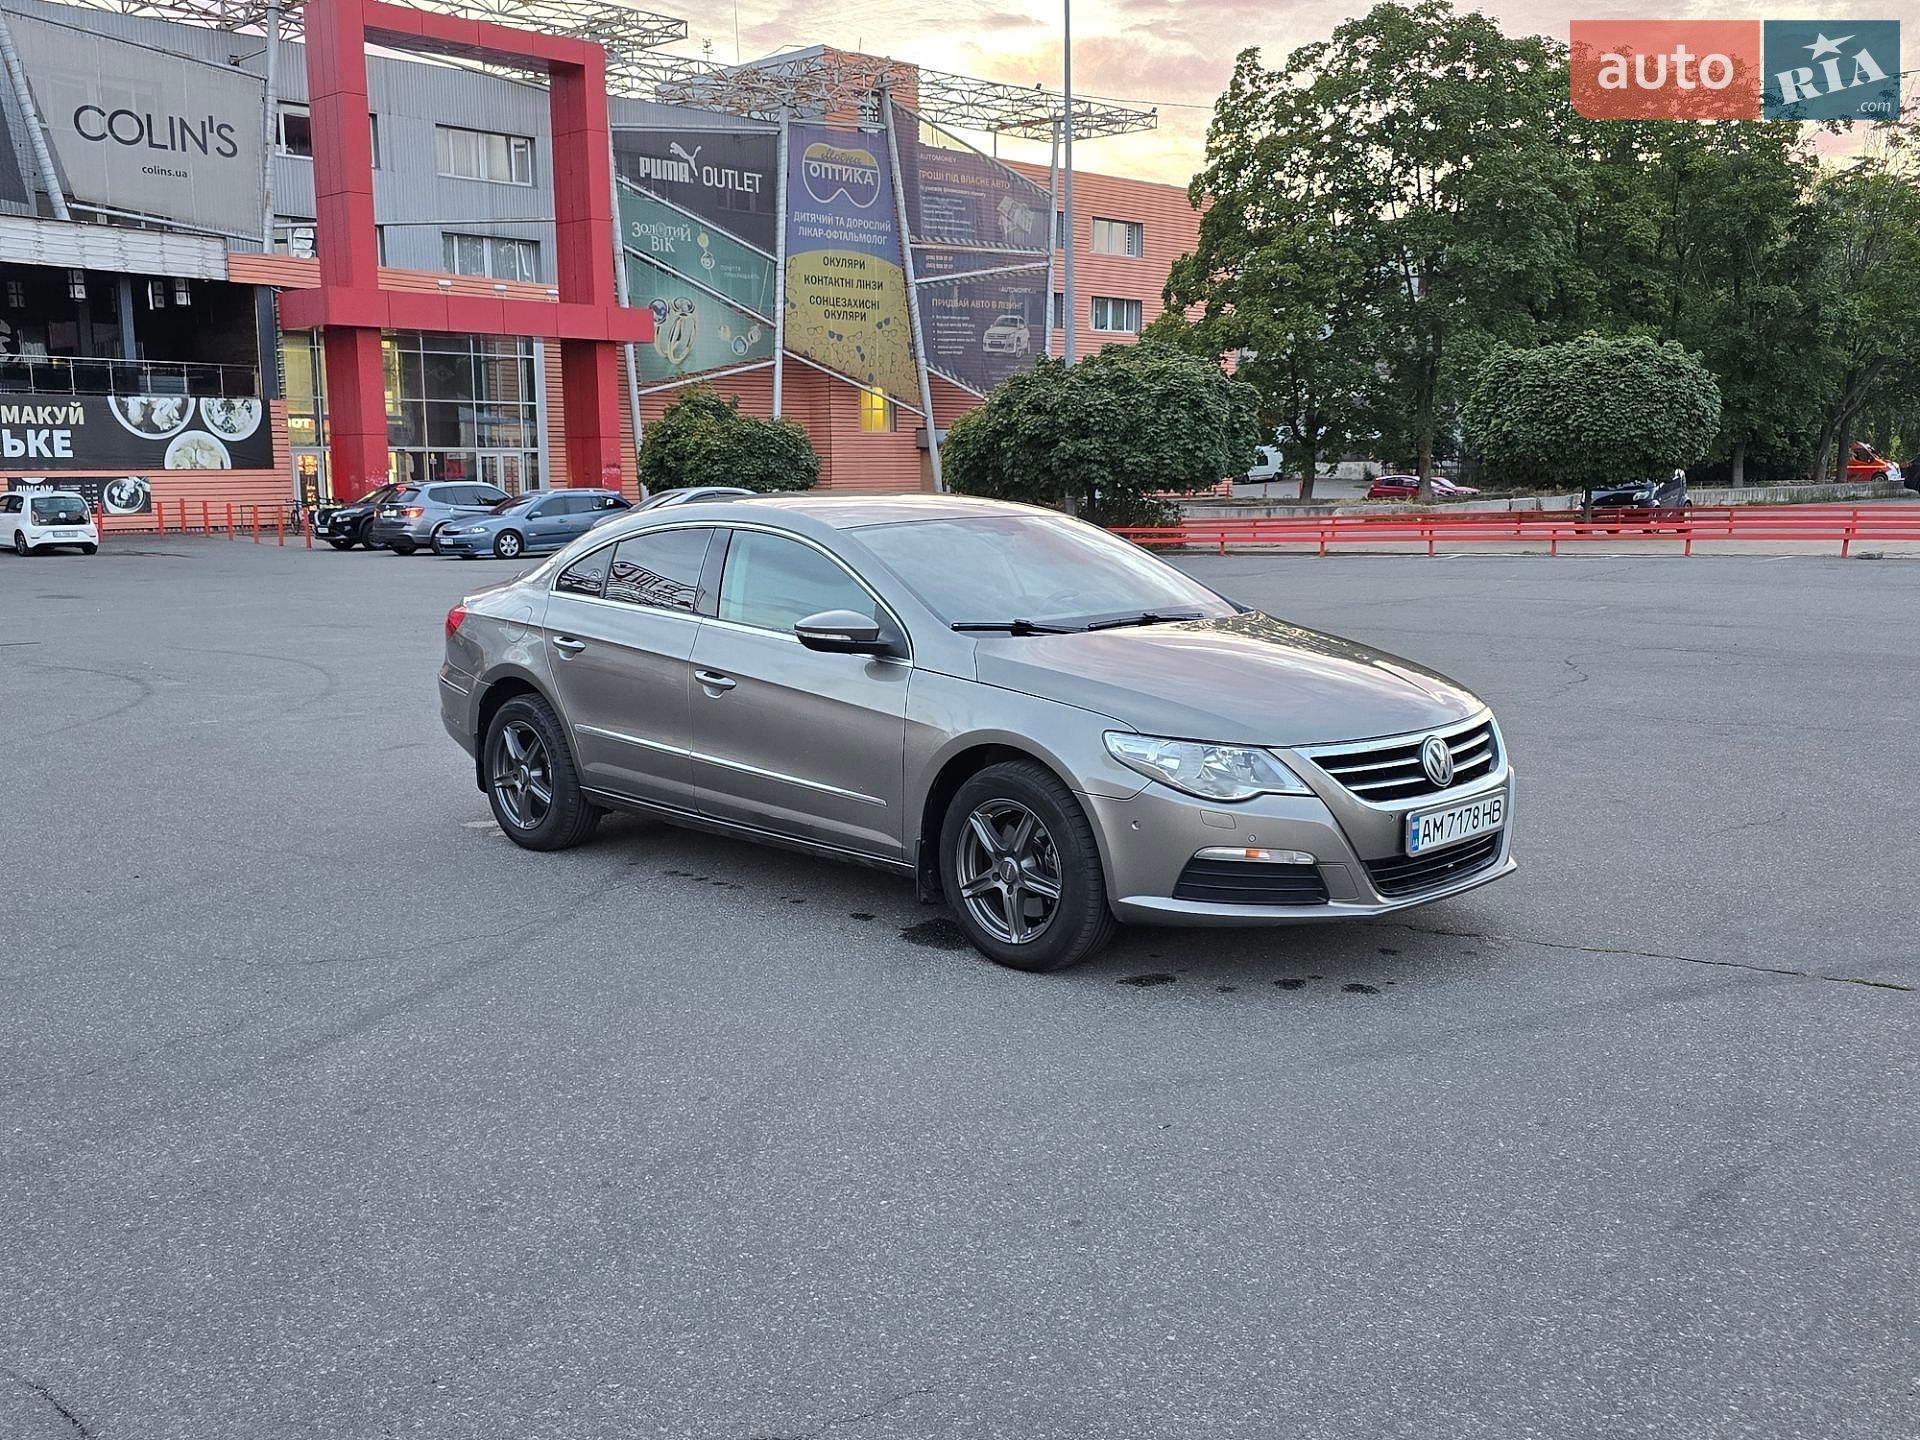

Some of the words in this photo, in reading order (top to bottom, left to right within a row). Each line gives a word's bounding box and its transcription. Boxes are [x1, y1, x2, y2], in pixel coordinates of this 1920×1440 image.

[73, 104, 238, 158] COLIN'S
[141, 165, 188, 178] colins.ua
[639, 157, 691, 183] PUMA
[702, 165, 763, 193] OUTLET
[809, 163, 874, 186] ОПТИКА
[945, 172, 959, 183] ПІД
[960, 175, 990, 186] ВЛАСНЕ
[991, 181, 1010, 189] АВТО
[793, 211, 834, 225] ДИТЯЧИЙ
[835, 217, 845, 227] ТА
[846, 218, 892, 232] ДОРОСЛИЙ
[798, 226, 888, 245] ЛІКАР-ОФТАЛЬМОЛОГ
[650, 236, 675, 253] ВІК
[822, 256, 866, 270] ОКУЛЯРИ
[804, 274, 854, 288] КОНТАКТНІ
[855, 279, 884, 291] ЛІНЗИ
[809, 295, 880, 310] СОНЦЕЗАХИСНІ
[931, 297, 969, 308] ПРИДБАЙ
[970, 300, 991, 309] АВТО
[823, 309, 867, 322] ОКУЛЯРИ
[0, 429, 74, 458] ЬКЕ
[1421, 814, 1445, 845] AM
[1447, 805, 1480, 838] 7178
[1481, 799, 1501, 828] HB
